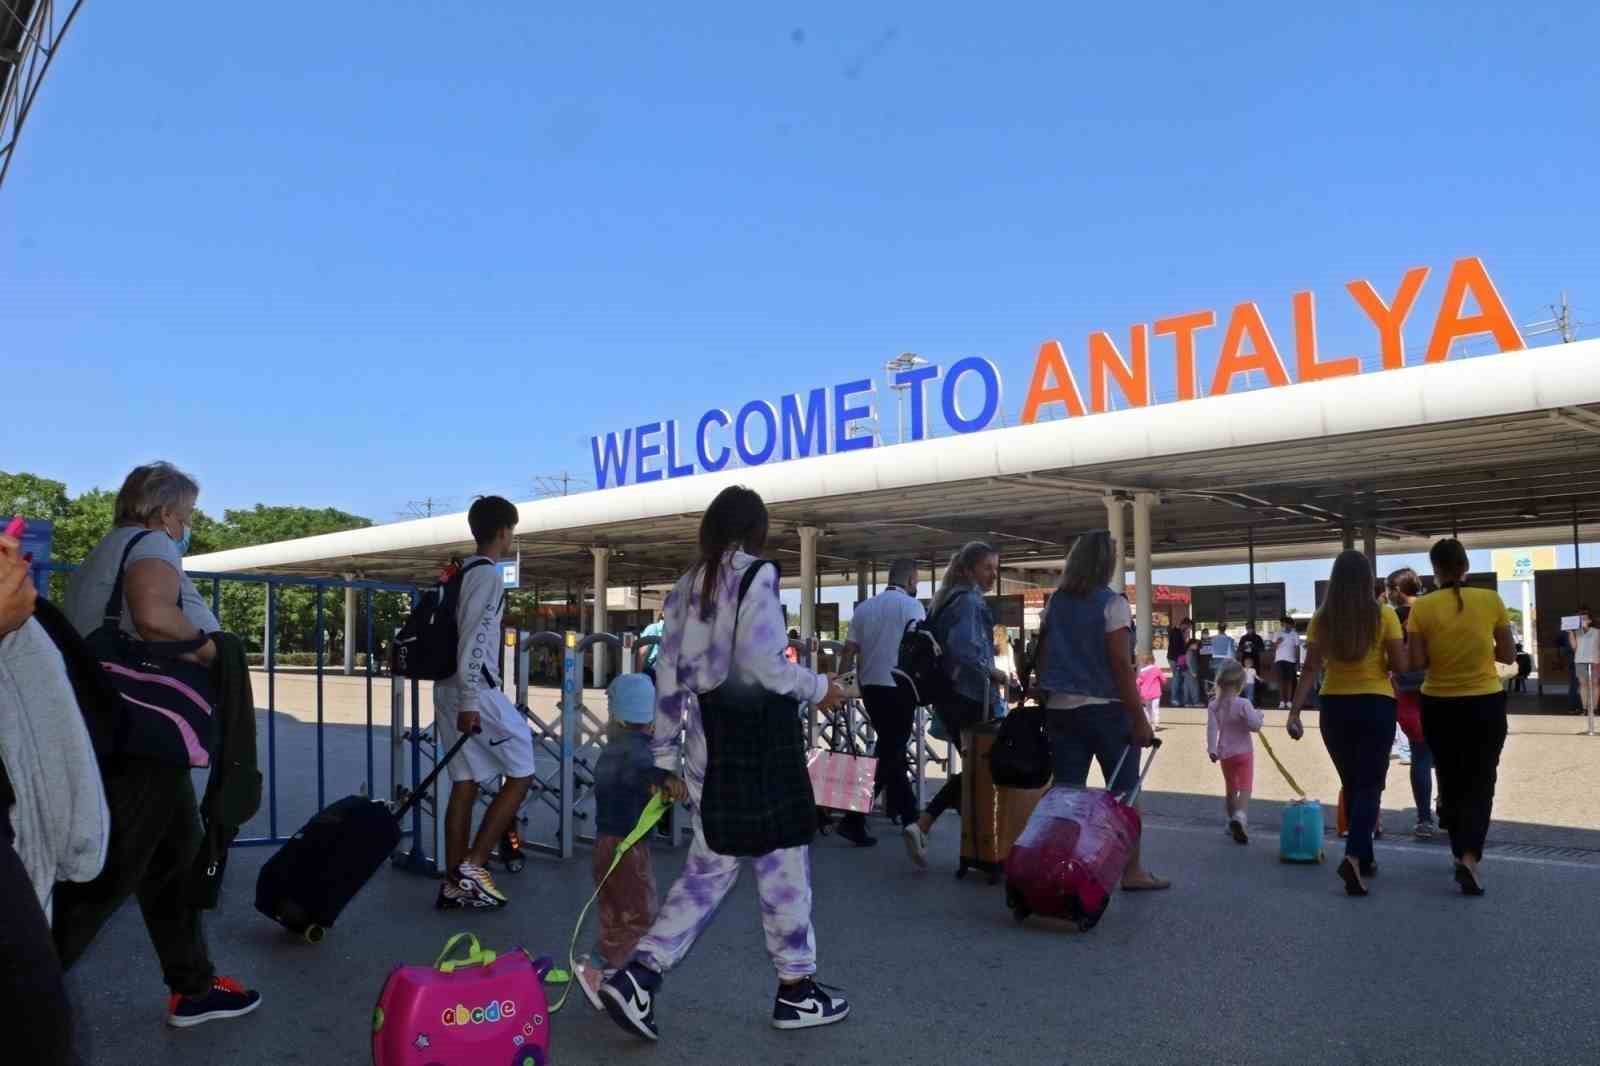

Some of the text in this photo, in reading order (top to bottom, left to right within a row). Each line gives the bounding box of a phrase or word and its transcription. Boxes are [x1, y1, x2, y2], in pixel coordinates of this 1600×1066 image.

[592, 256, 1527, 489] WELCOME TO ANTALYA
[467, 603, 496, 684] SWOOSH
[441, 1000, 516, 1026] abcde
